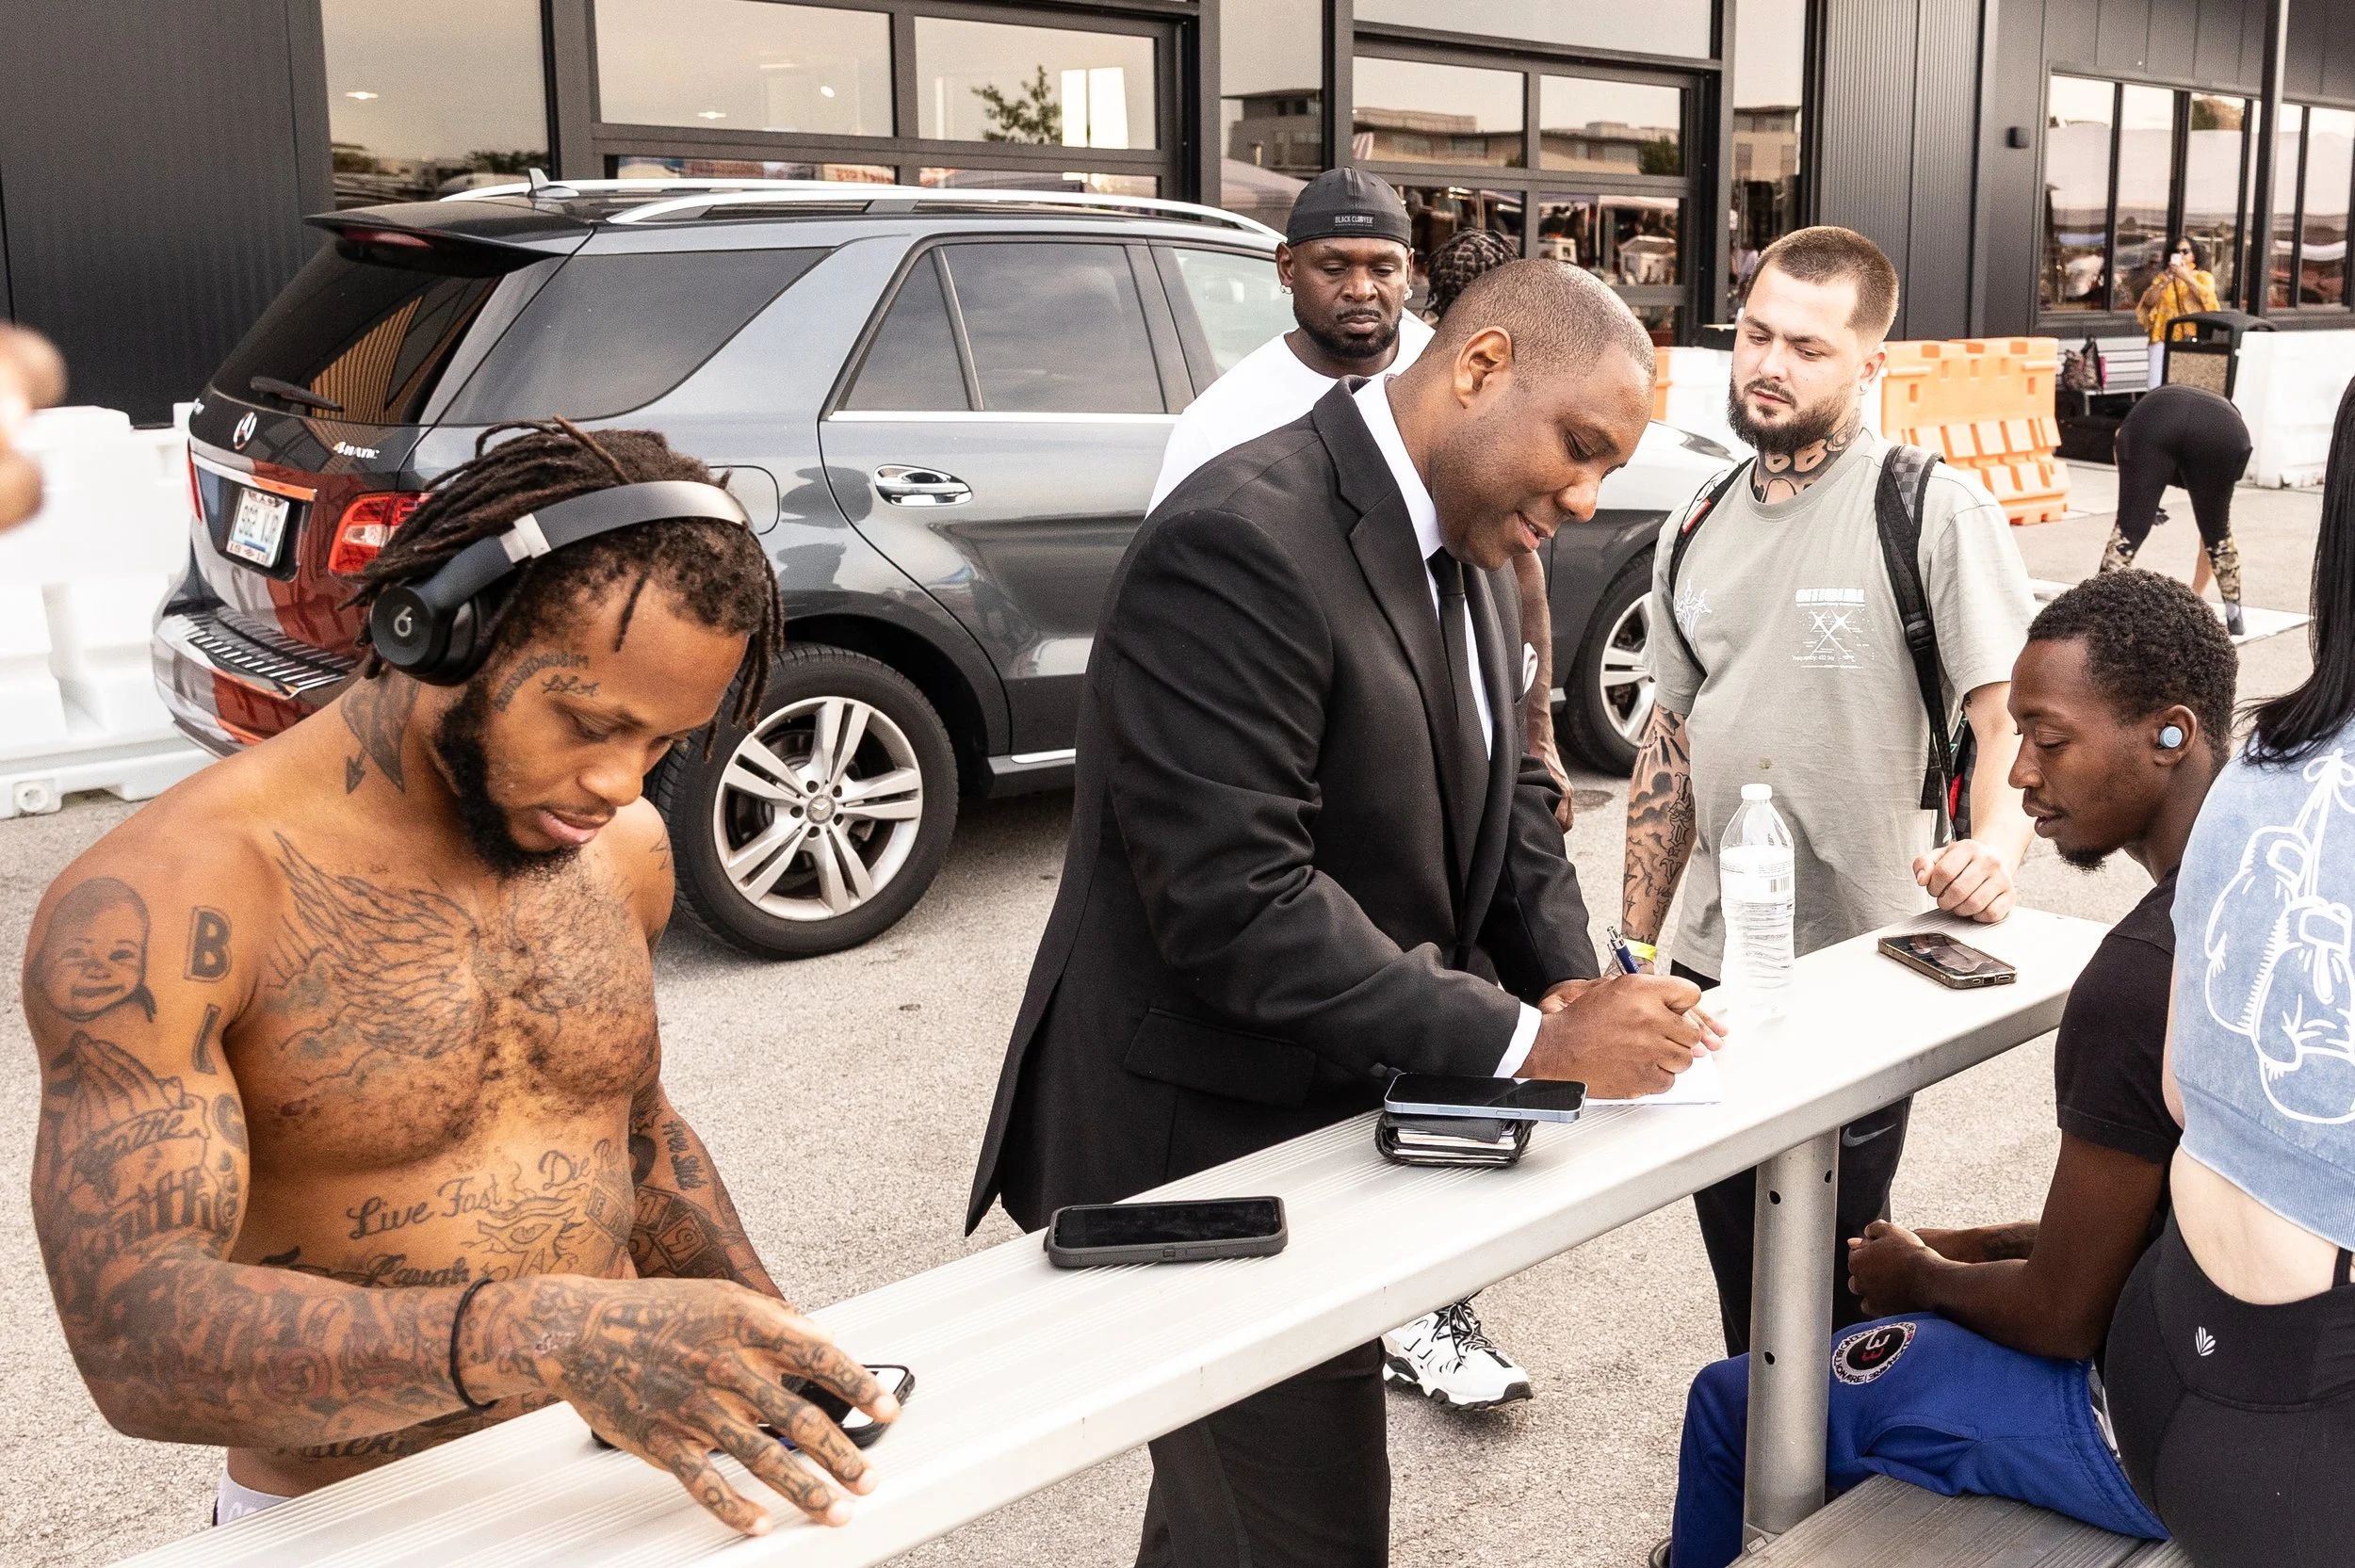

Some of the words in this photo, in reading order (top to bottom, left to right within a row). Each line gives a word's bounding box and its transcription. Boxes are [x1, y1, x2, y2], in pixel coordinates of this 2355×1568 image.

[347, 1195, 435, 1240] Live
[437, 1172, 503, 1218] Fast
[538, 1149, 592, 1190] Die
